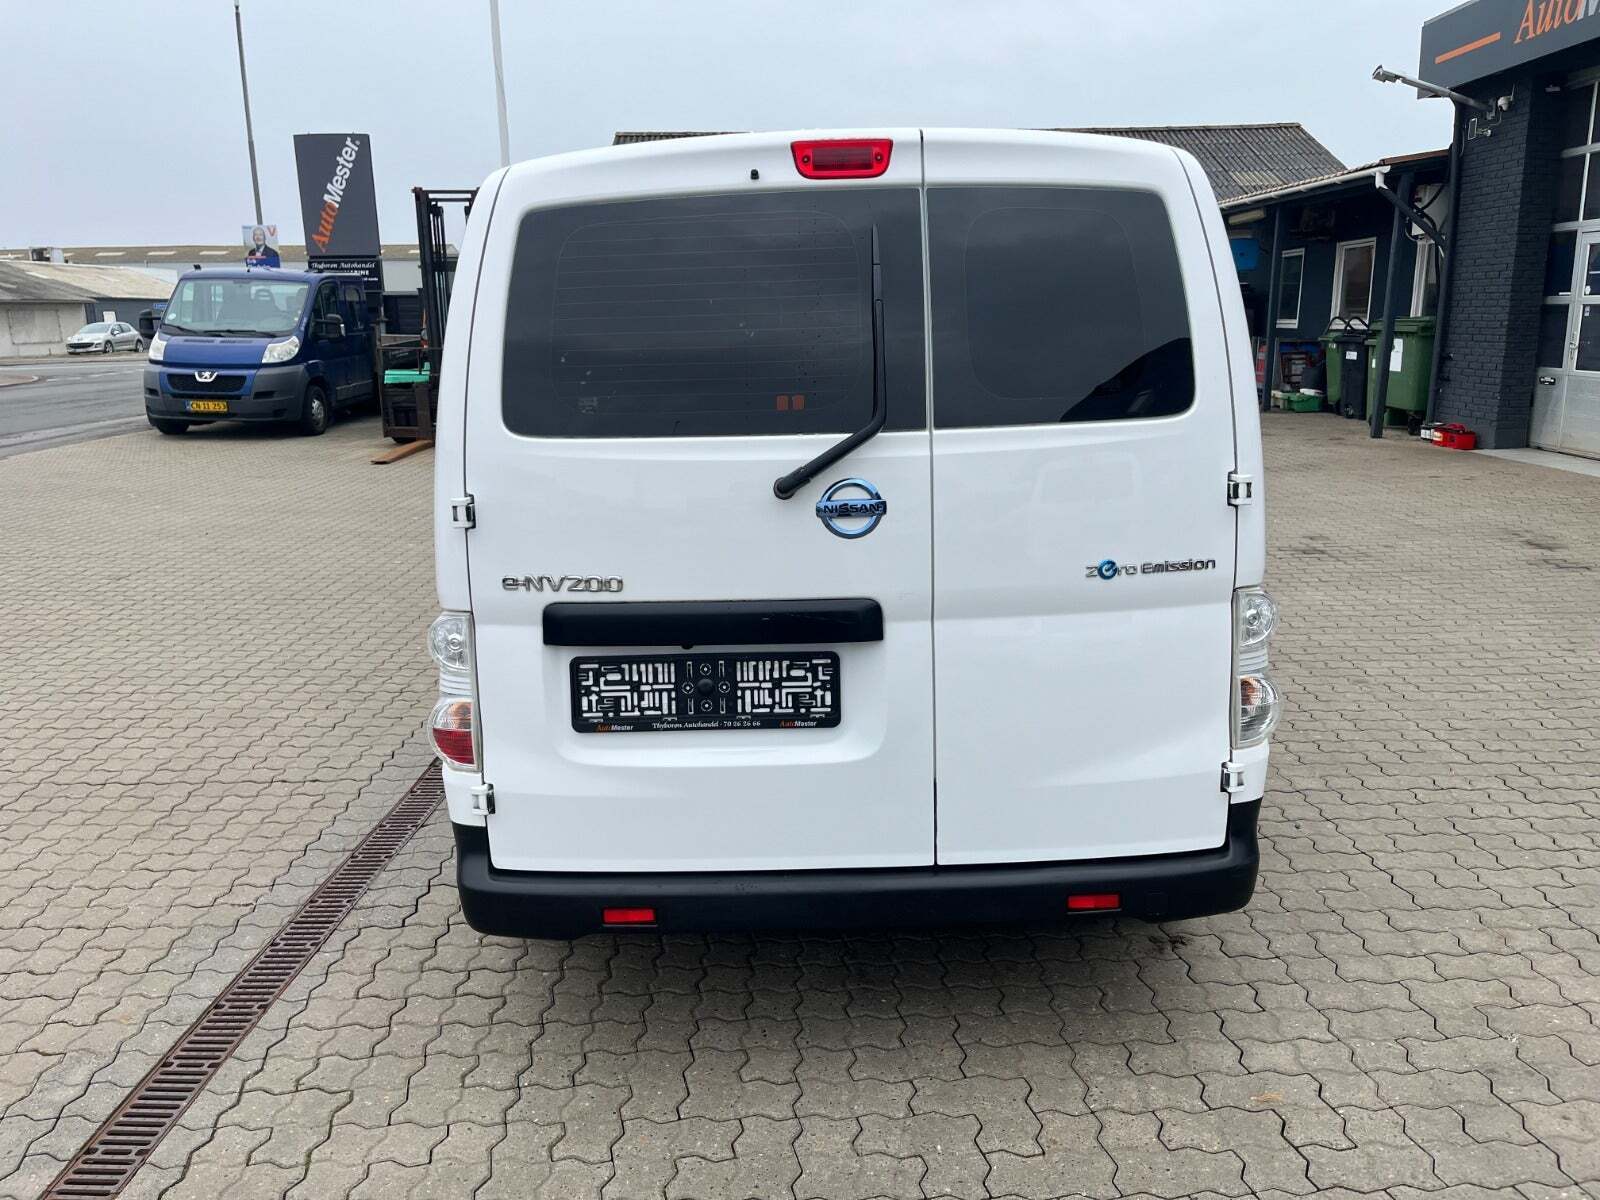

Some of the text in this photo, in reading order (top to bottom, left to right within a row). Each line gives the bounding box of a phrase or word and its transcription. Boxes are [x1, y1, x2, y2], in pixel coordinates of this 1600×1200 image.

[312, 136, 360, 253] AutoMester
[823, 503, 882, 514] NISSAN
[1141, 559, 1216, 574] Emission
[502, 575, 624, 592] e-NV200
[684, 720, 719, 728] Autohandel
